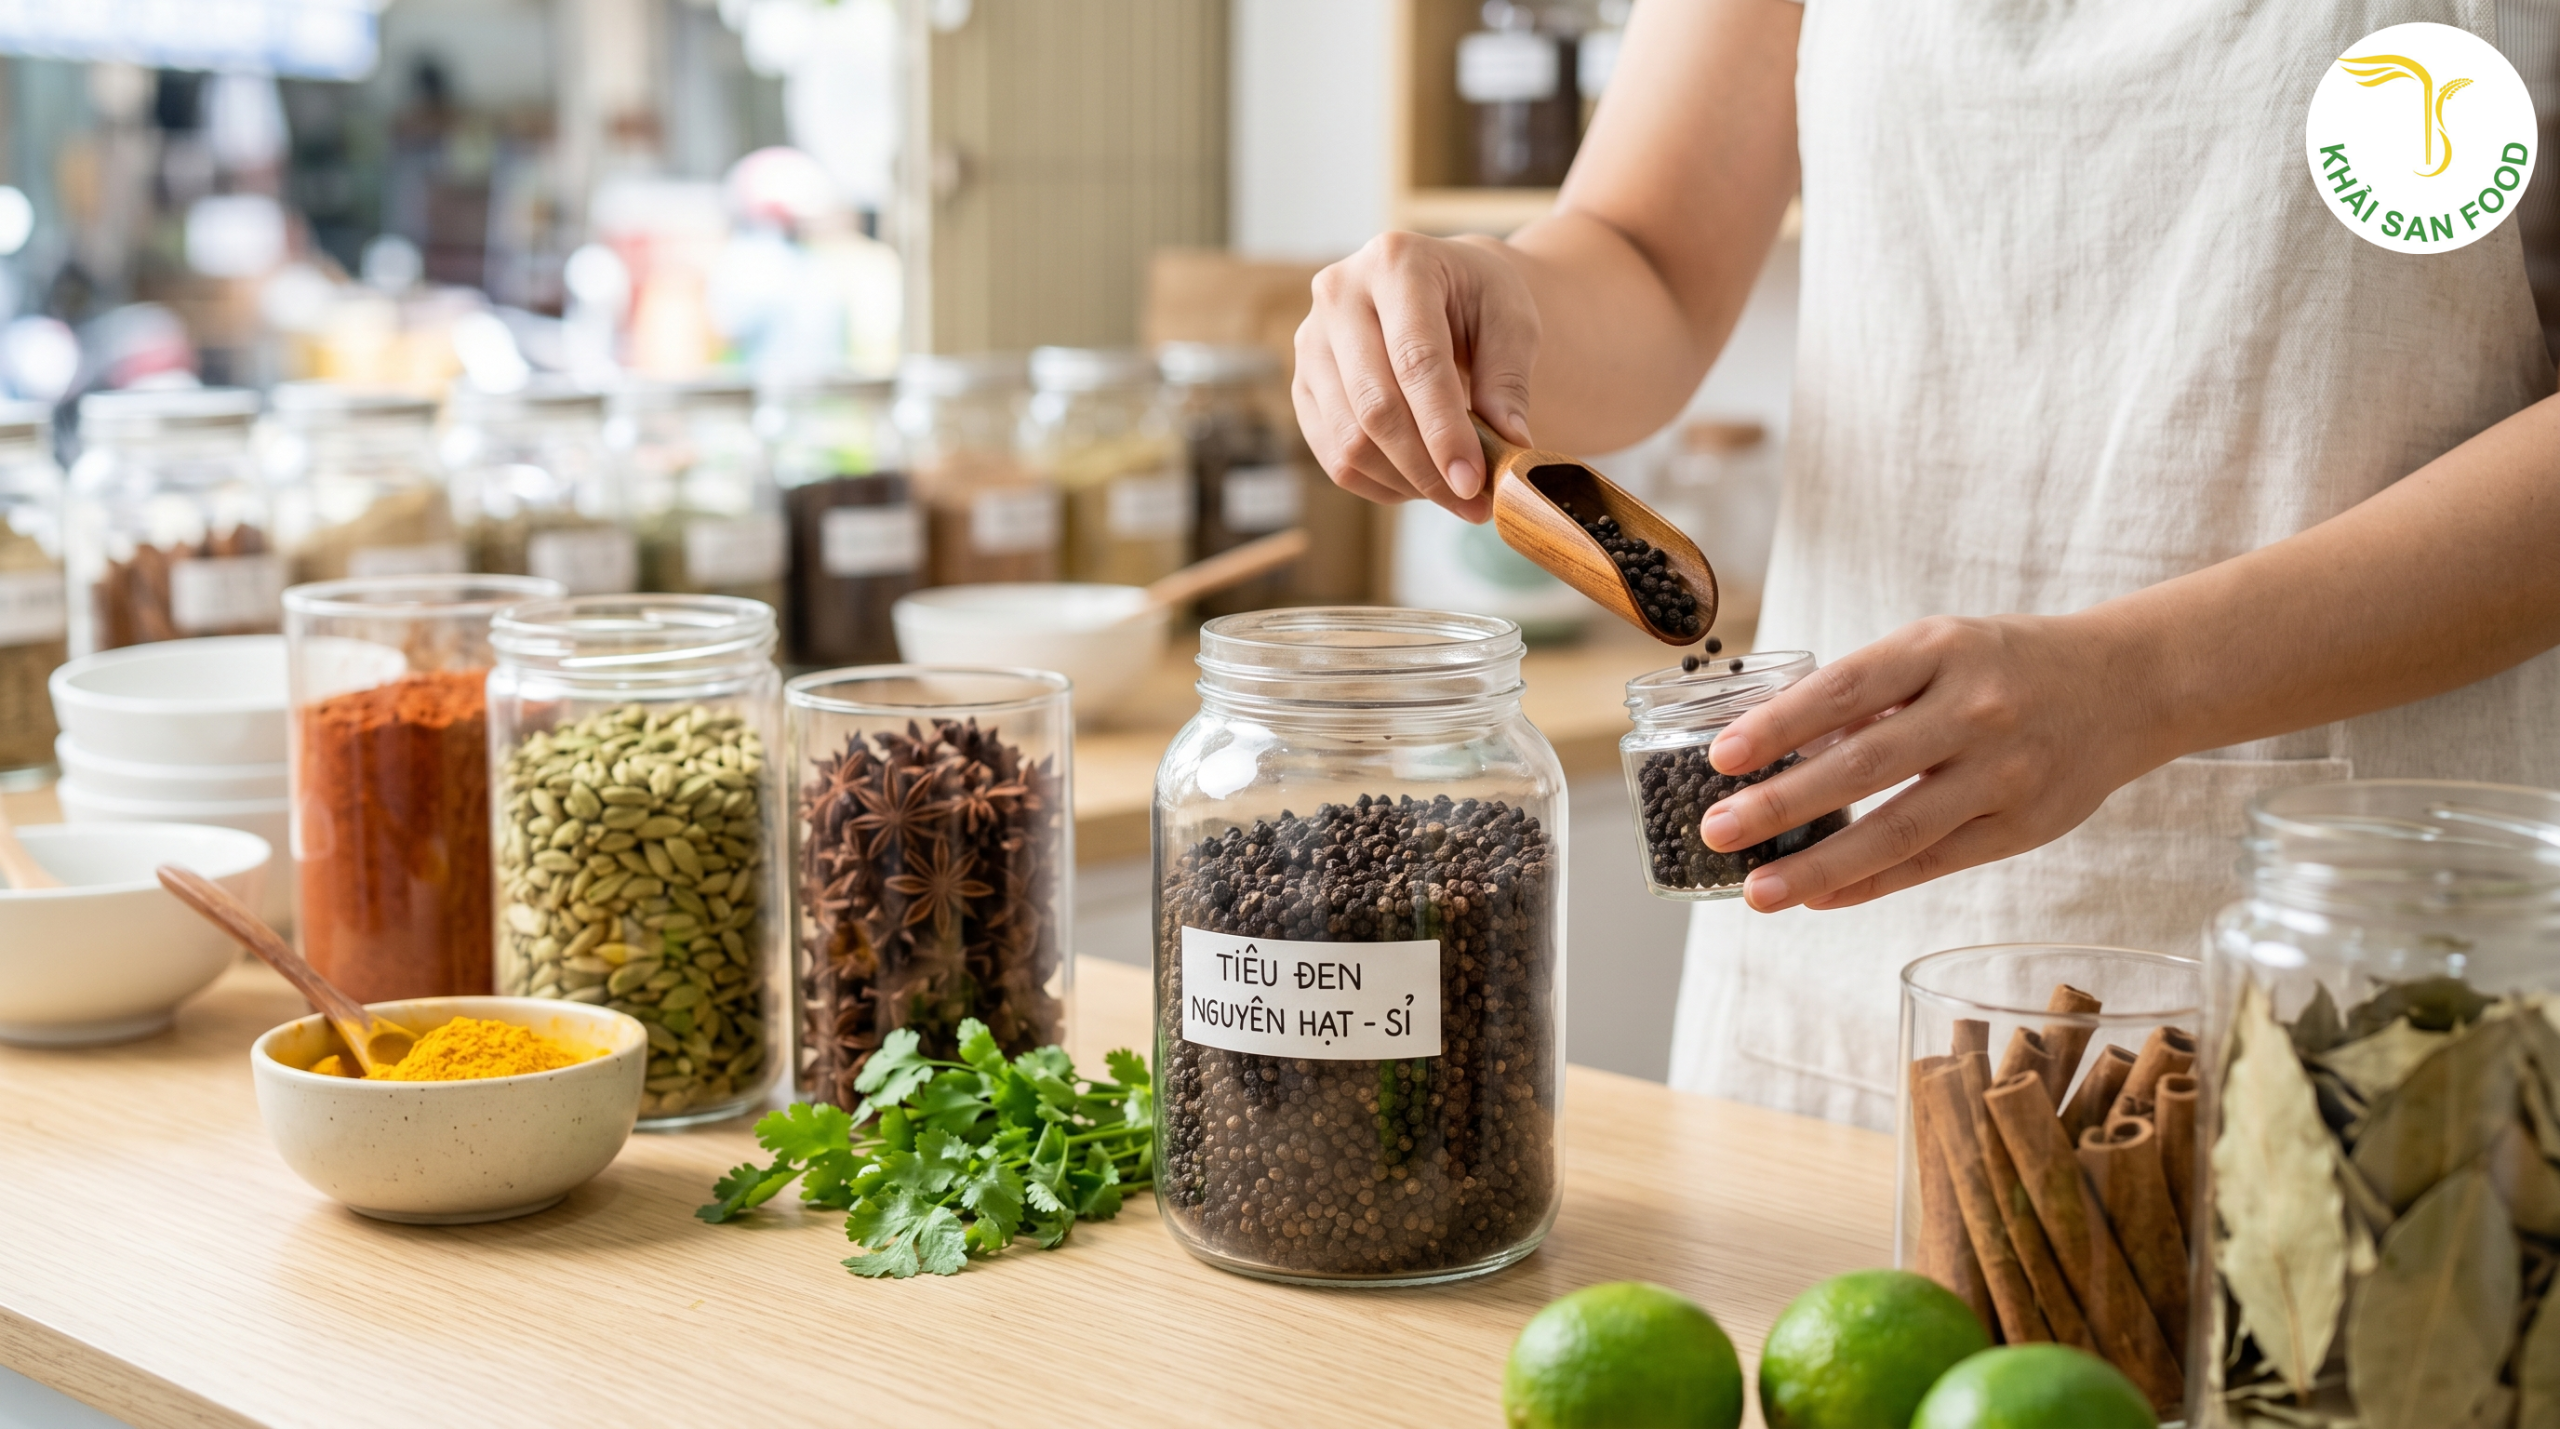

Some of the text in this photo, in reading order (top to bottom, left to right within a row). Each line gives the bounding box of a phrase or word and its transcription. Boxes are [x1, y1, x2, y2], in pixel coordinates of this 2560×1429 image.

[1293, 961, 1361, 991] ĐEN
[1191, 995, 1285, 1035] NGUYÊN
[1299, 1010, 1354, 1046] HẠT
[1384, 993, 1415, 1037] SỈ
